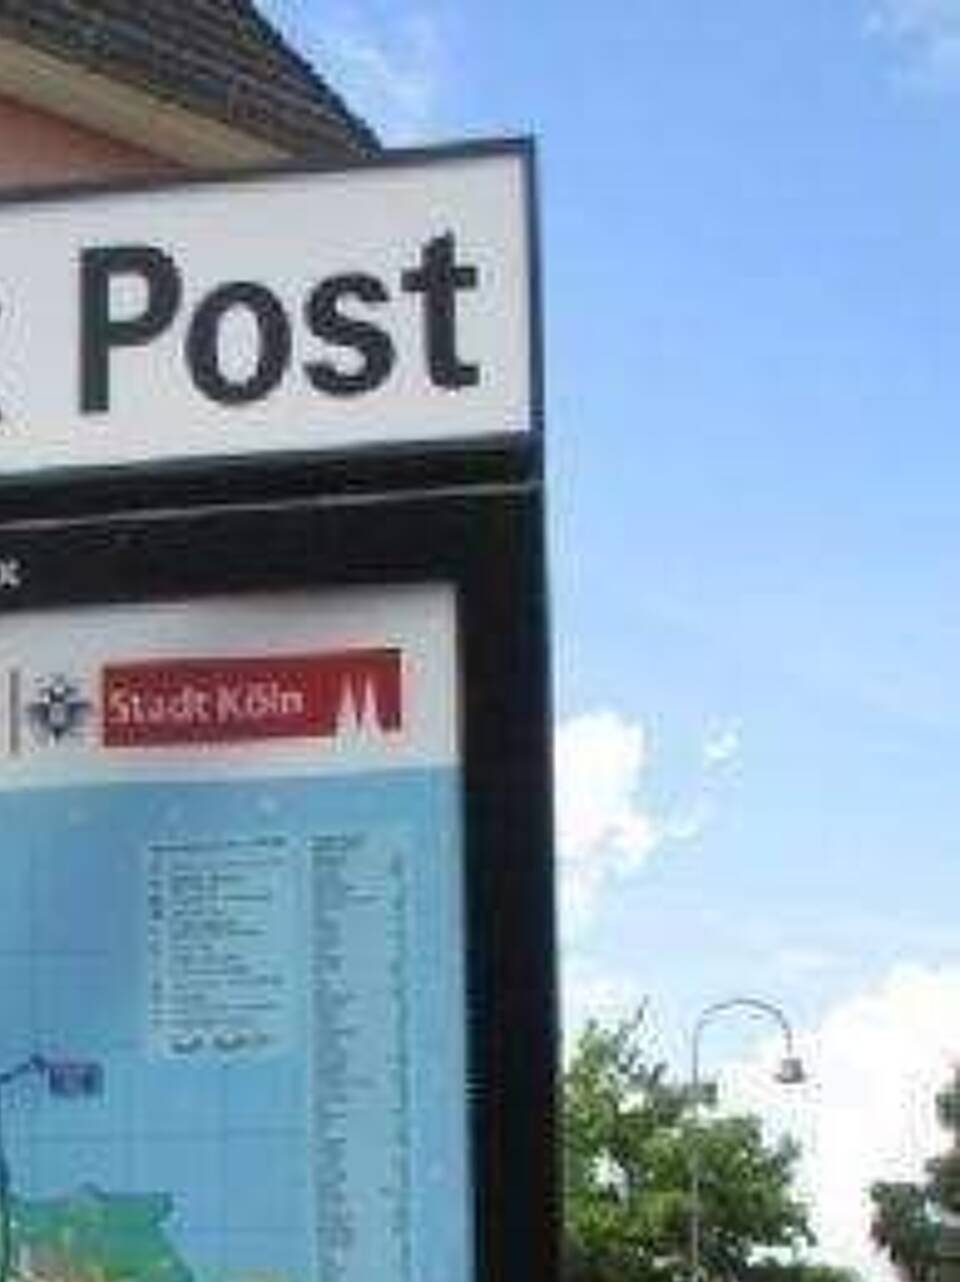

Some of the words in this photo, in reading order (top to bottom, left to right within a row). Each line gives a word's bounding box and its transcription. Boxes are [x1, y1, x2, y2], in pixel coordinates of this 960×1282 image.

[77, 230, 480, 415] Post
[108, 685, 210, 723] Stadt
[216, 681, 305, 723] Köln
